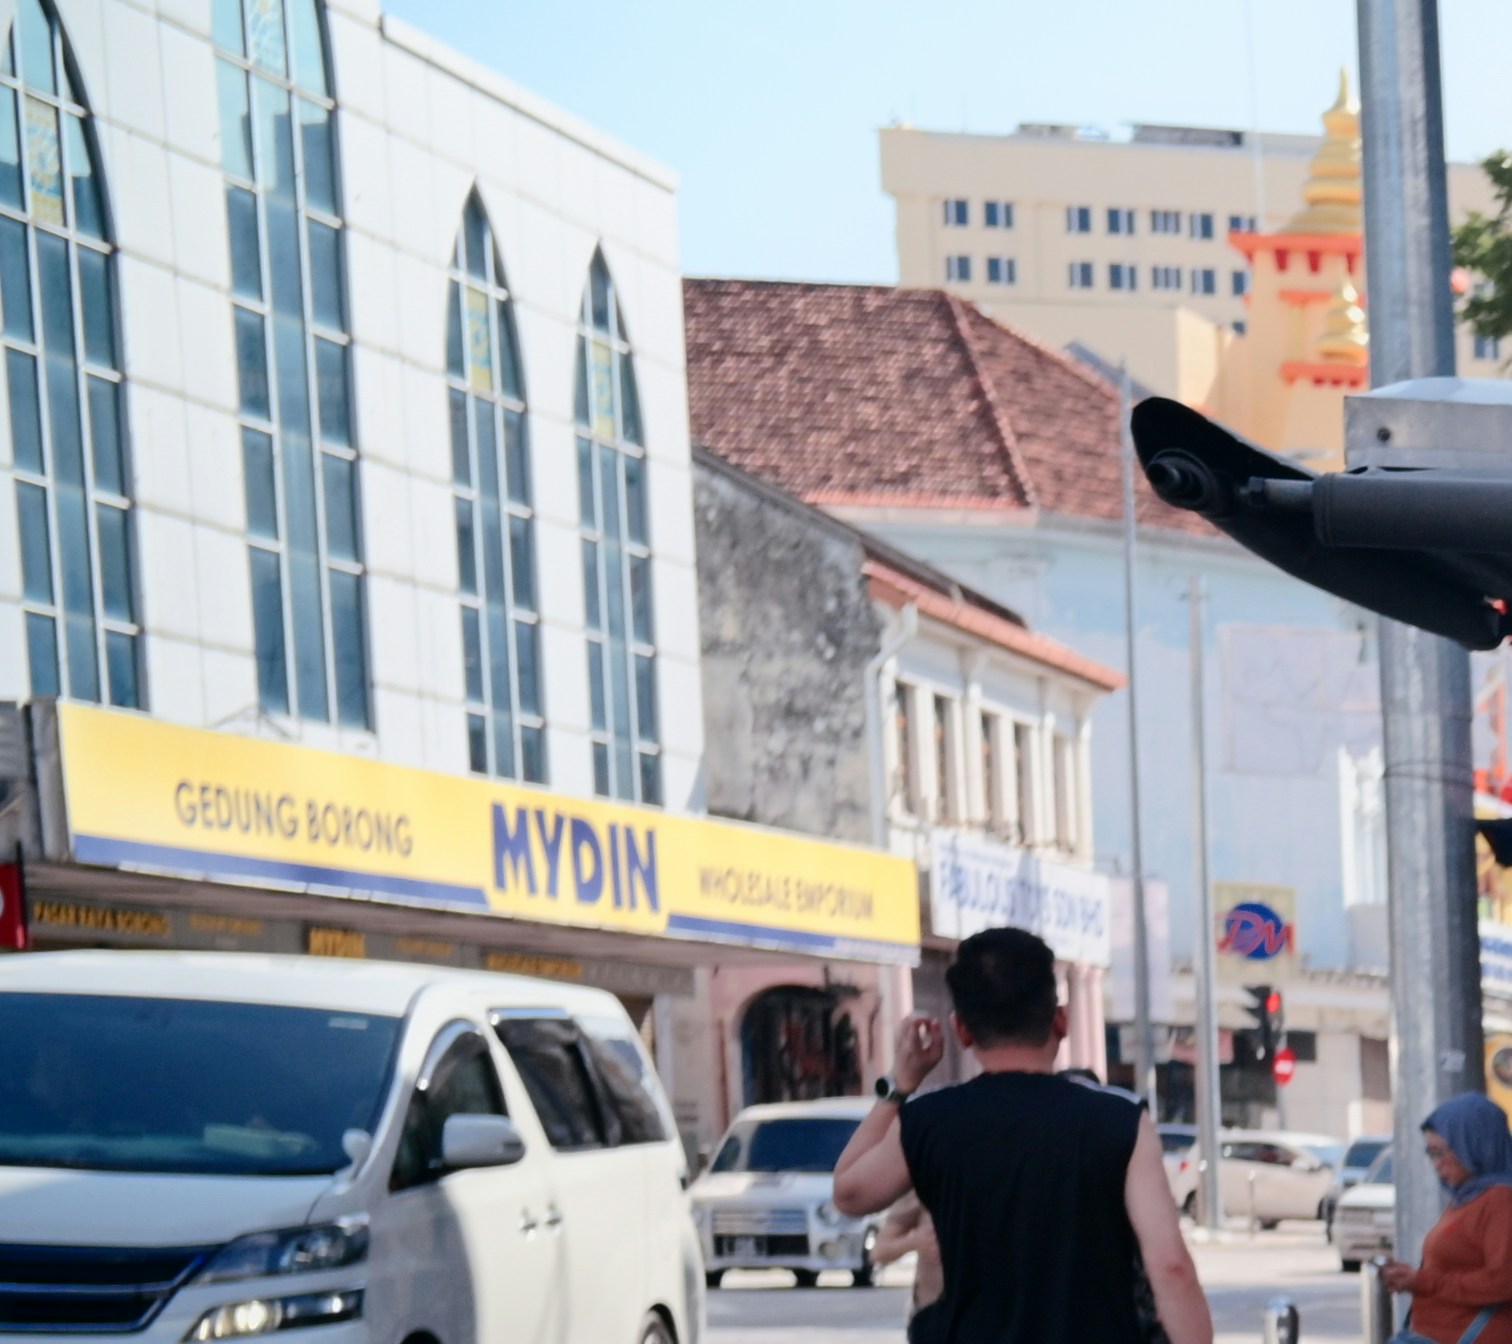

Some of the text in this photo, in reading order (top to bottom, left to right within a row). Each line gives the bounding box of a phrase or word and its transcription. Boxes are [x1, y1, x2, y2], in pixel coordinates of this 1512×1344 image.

[174, 777, 414, 858] GEDUNG BORONG
[490, 802, 661, 914] MYDIN
[699, 865, 875, 921] WHOLESALE EMPORIUM
